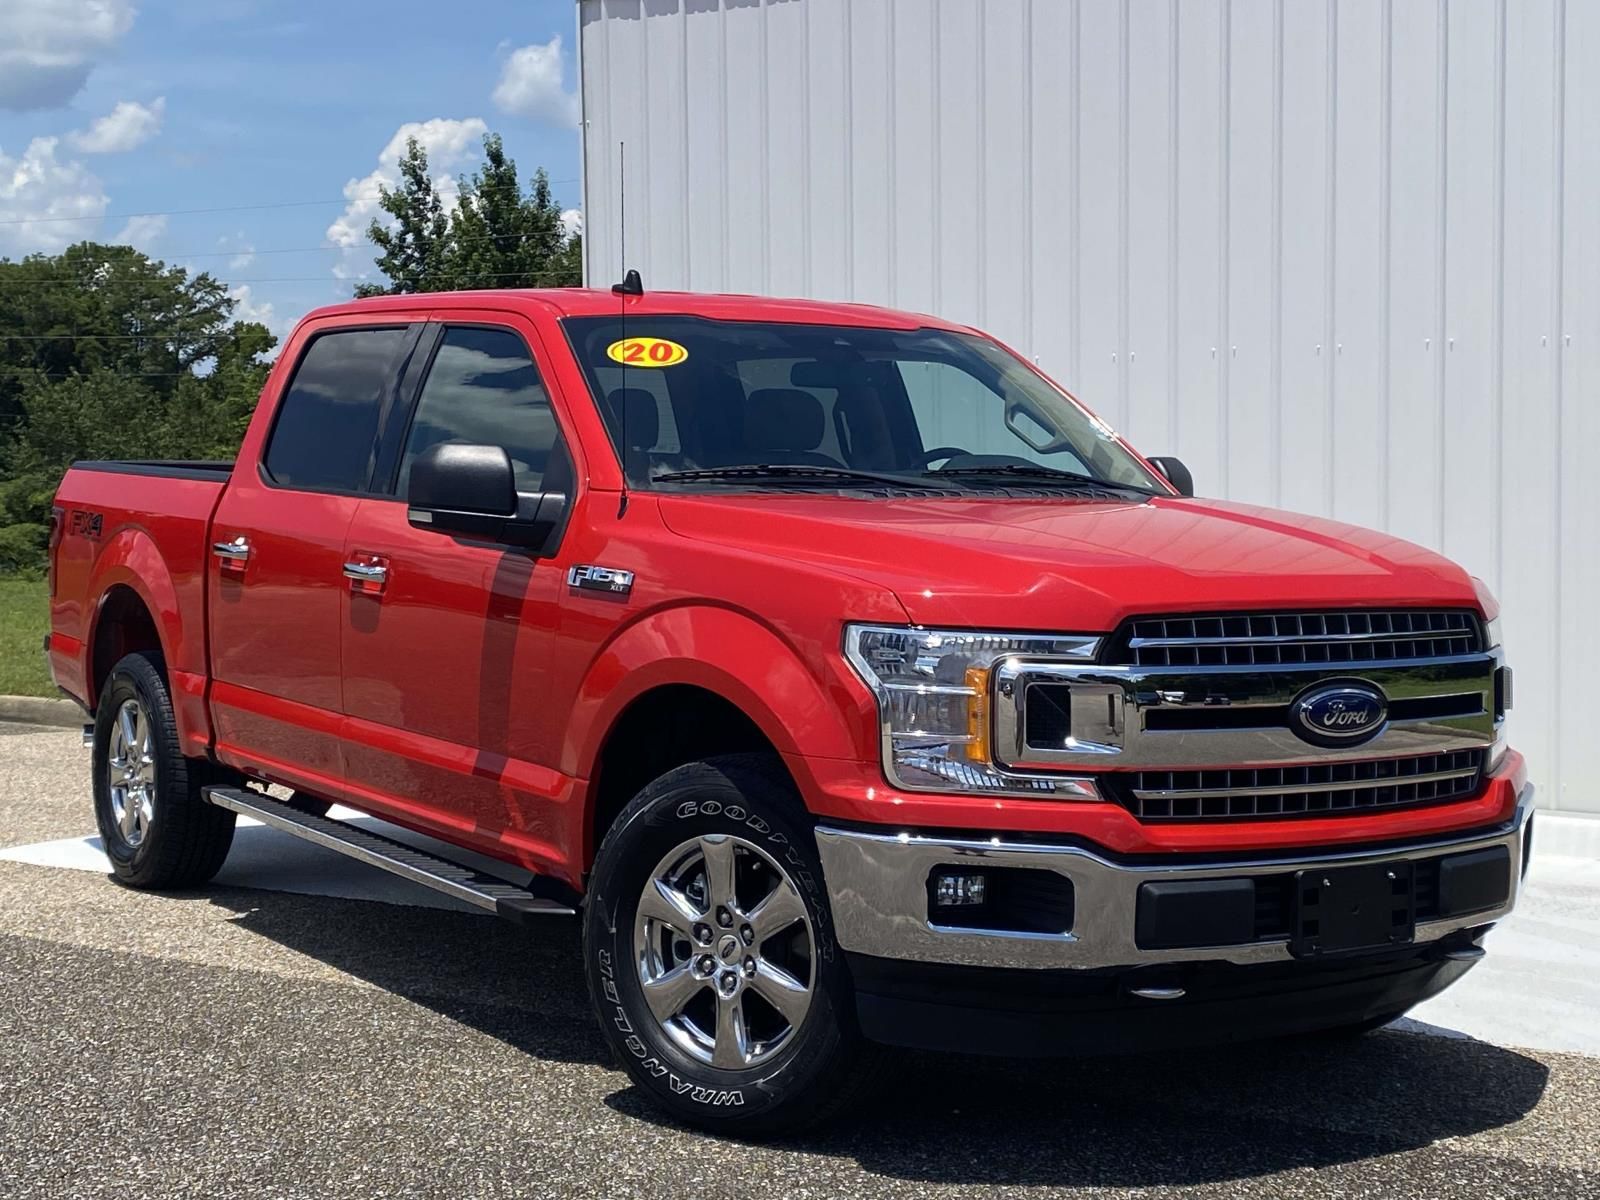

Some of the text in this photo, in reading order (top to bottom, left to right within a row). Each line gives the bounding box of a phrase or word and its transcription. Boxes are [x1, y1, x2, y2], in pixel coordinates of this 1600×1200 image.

[623, 342, 673, 362] 20
[1324, 699, 1369, 726] Ford
[676, 800, 835, 963] GOODYEAR
[599, 949, 745, 1106] WRANGLER
